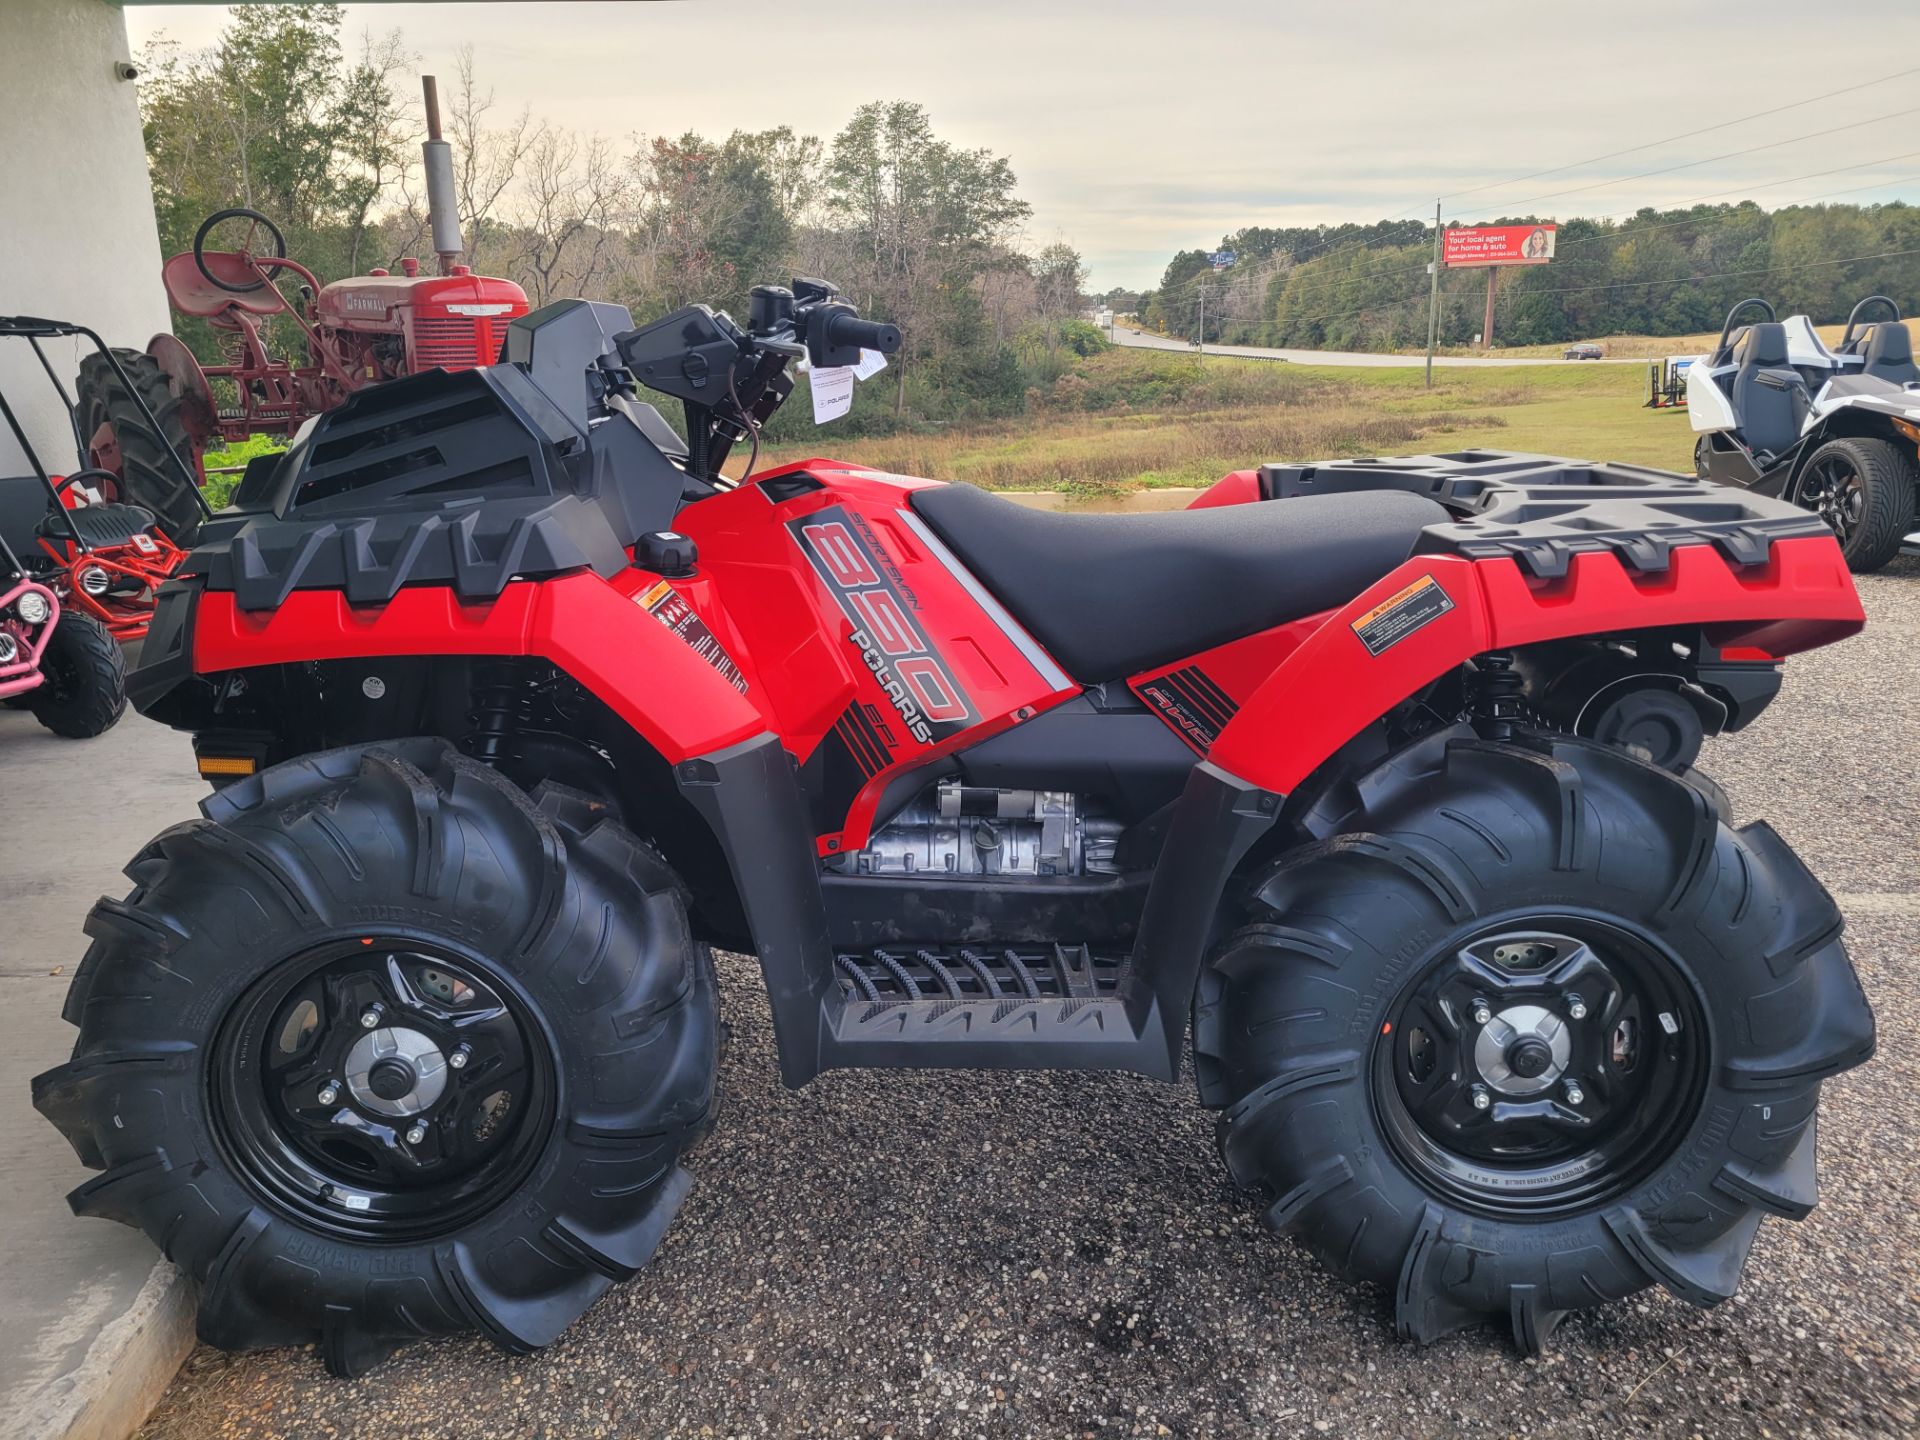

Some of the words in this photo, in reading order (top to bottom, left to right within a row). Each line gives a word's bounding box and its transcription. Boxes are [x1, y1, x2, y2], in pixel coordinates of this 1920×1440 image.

[1467, 235, 1484, 243] local
[1485, 235, 1506, 243] agent
[1483, 243, 1489, 251] &
[353, 298, 386, 311] FARMALL
[827, 393, 850, 405] POLARIS
[850, 511, 923, 611] SPORTSMAN
[1380, 588, 1414, 612] WARNING
[802, 522, 969, 723] 850
[849, 628, 933, 745] POLARIS
[863, 703, 899, 748] EFI
